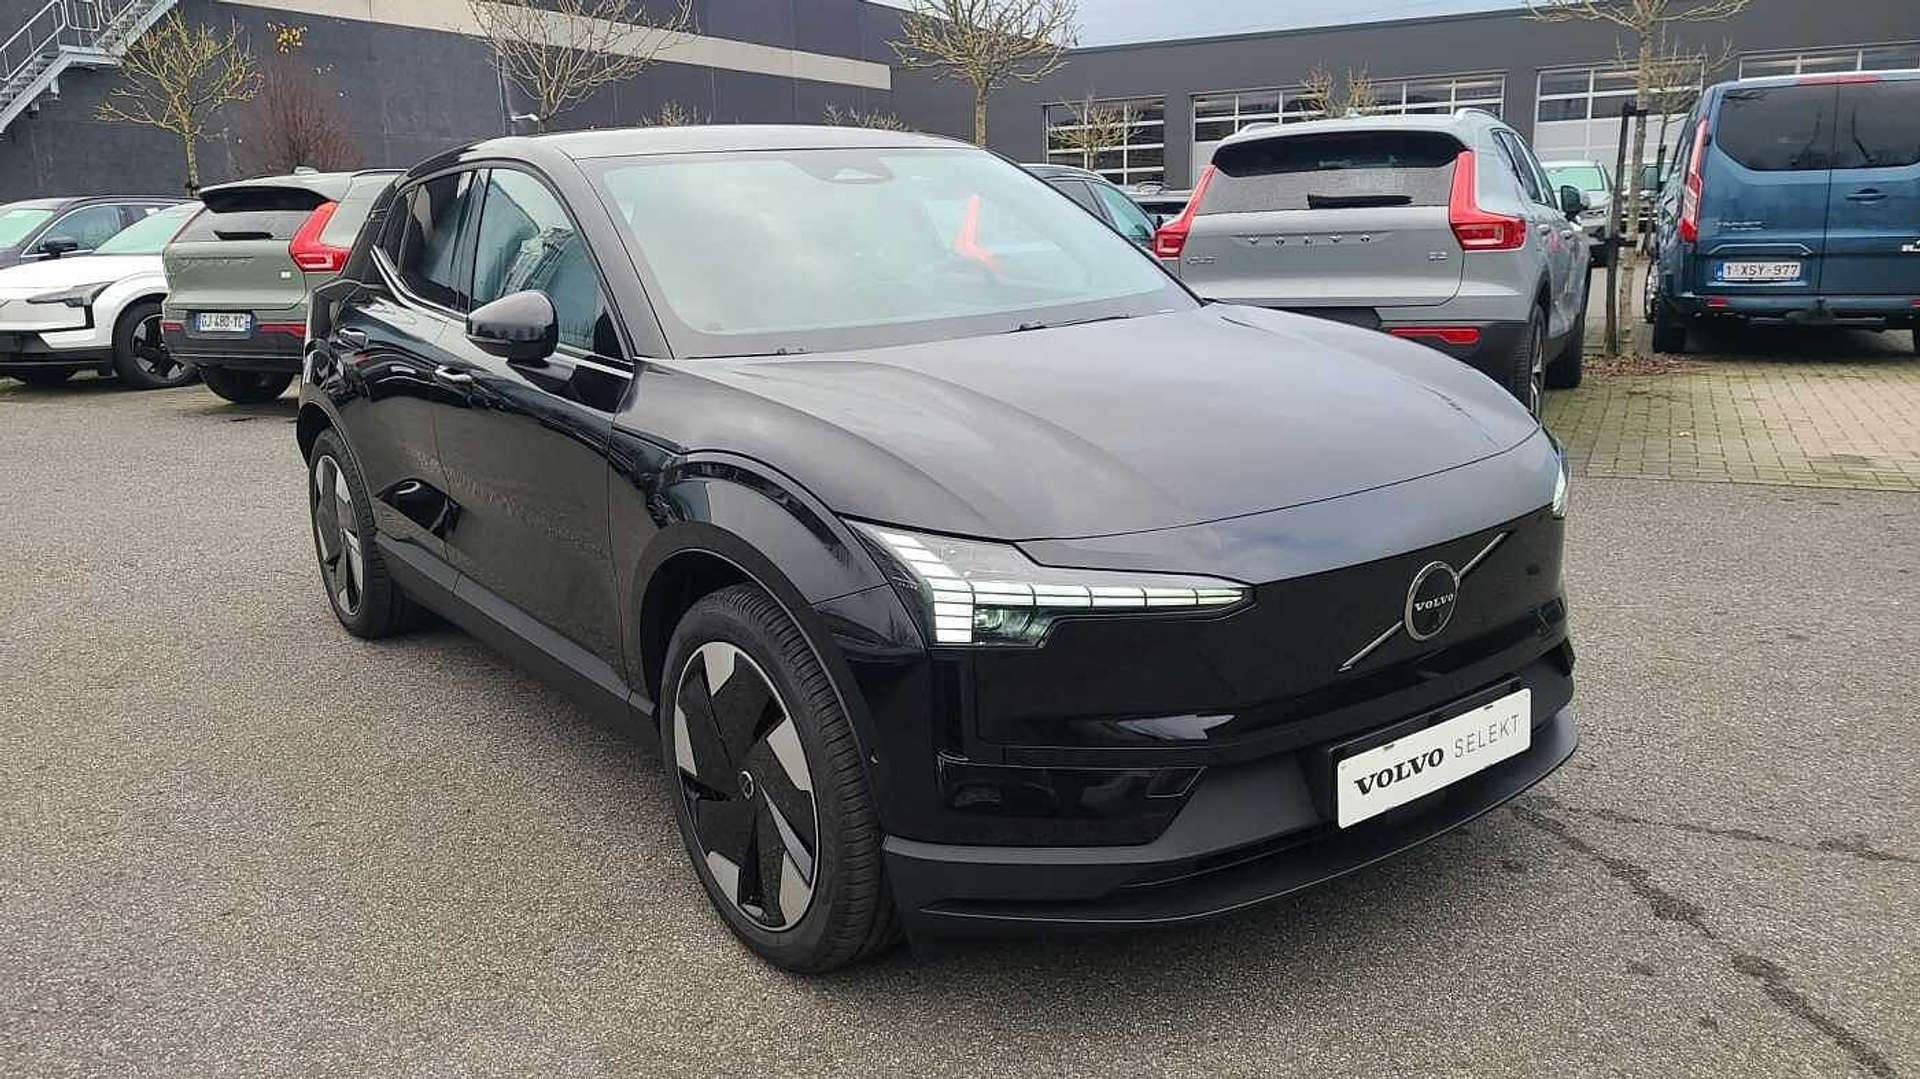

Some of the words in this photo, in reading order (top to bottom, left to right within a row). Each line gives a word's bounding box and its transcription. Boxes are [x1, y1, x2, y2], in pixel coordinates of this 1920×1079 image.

[1414, 593, 1454, 611] VOLVO
[1353, 747, 1444, 795] VOLVO
[1454, 713, 1521, 758] SELEKT
